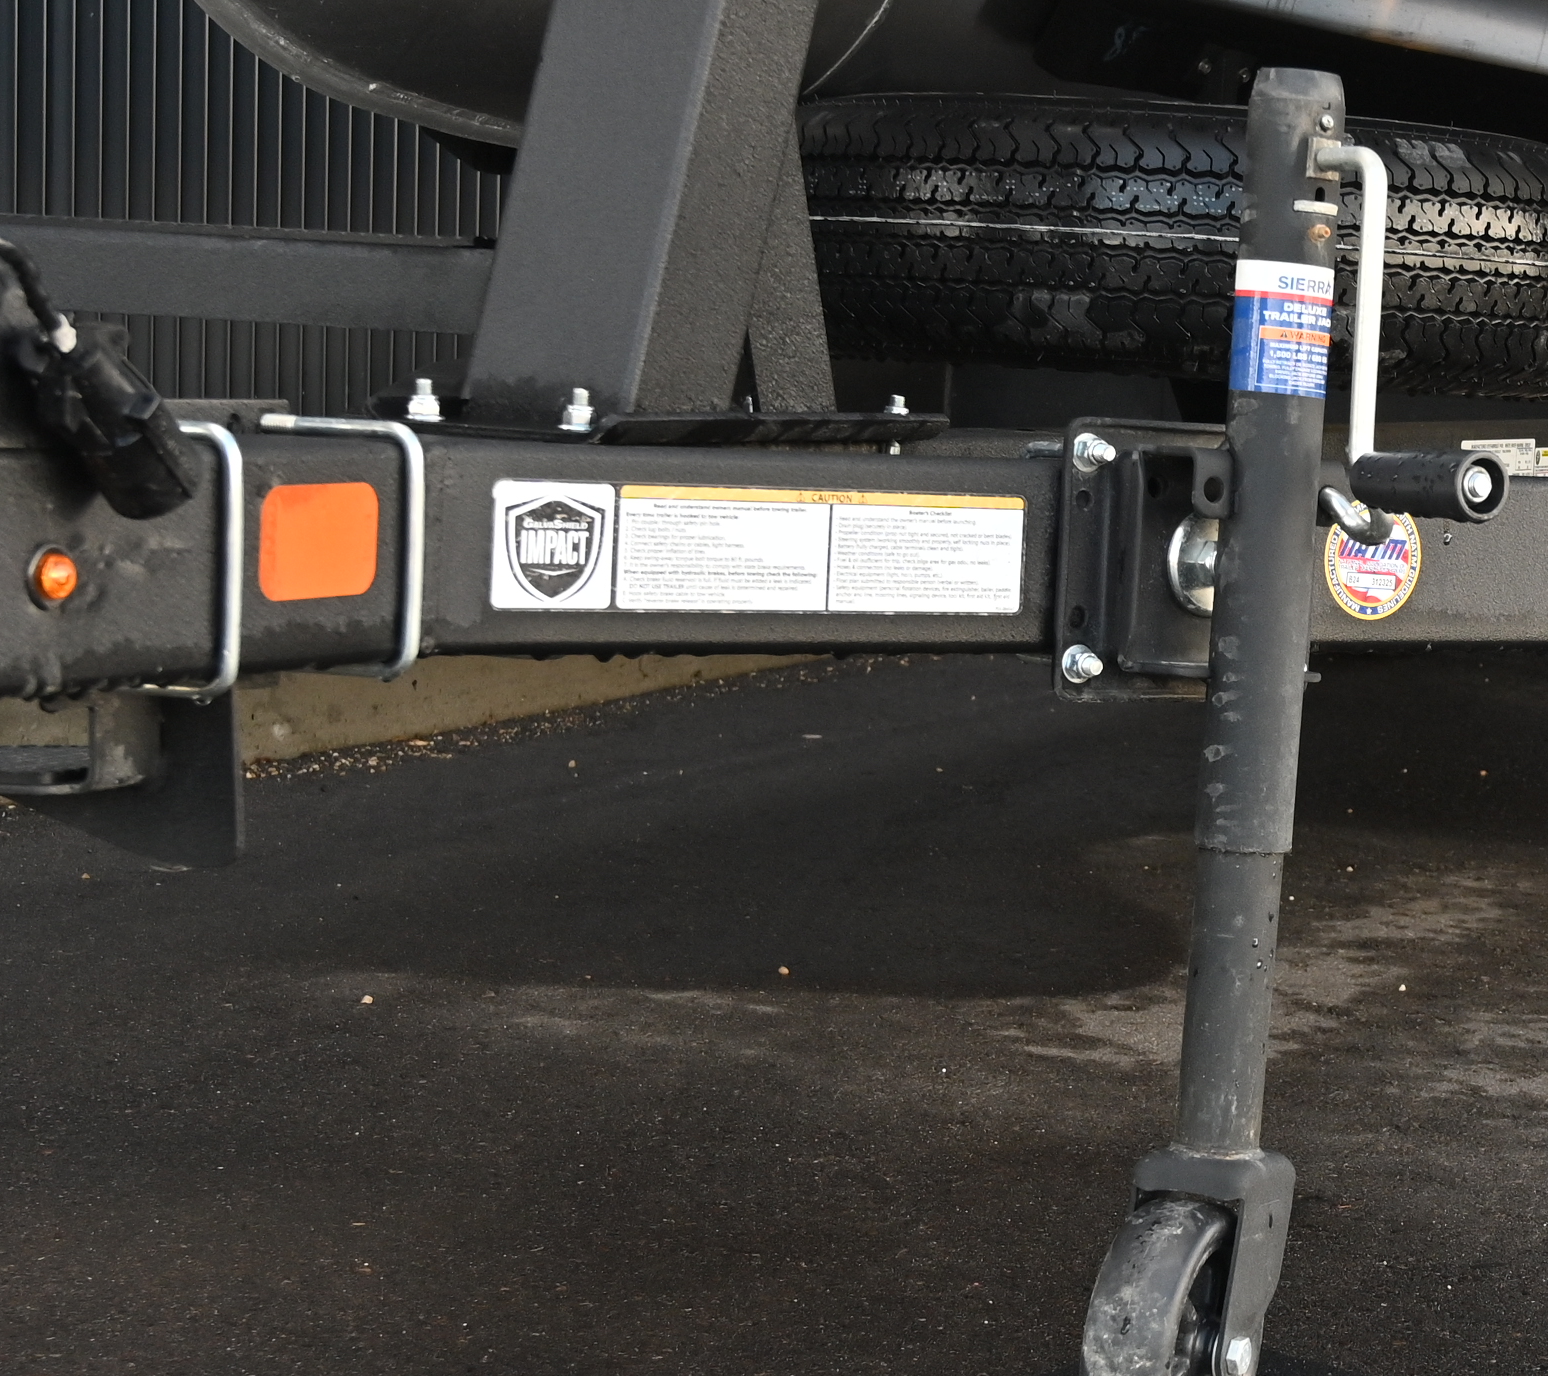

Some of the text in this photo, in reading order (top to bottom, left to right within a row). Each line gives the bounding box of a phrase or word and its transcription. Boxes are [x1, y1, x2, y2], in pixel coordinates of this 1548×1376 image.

[1278, 275, 1331, 295] SIERRA
[1263, 310, 1316, 325] TRAILER
[1283, 302, 1327, 316] DELUXE
[1290, 331, 1326, 343] WARNING
[811, 493, 852, 503] CAUTION
[520, 529, 590, 565] IMPACT
[1409, 536, 1418, 567] NATM
[1328, 536, 1360, 612] MANUFACTURED
[1377, 570, 1415, 613] GUIDELINES
